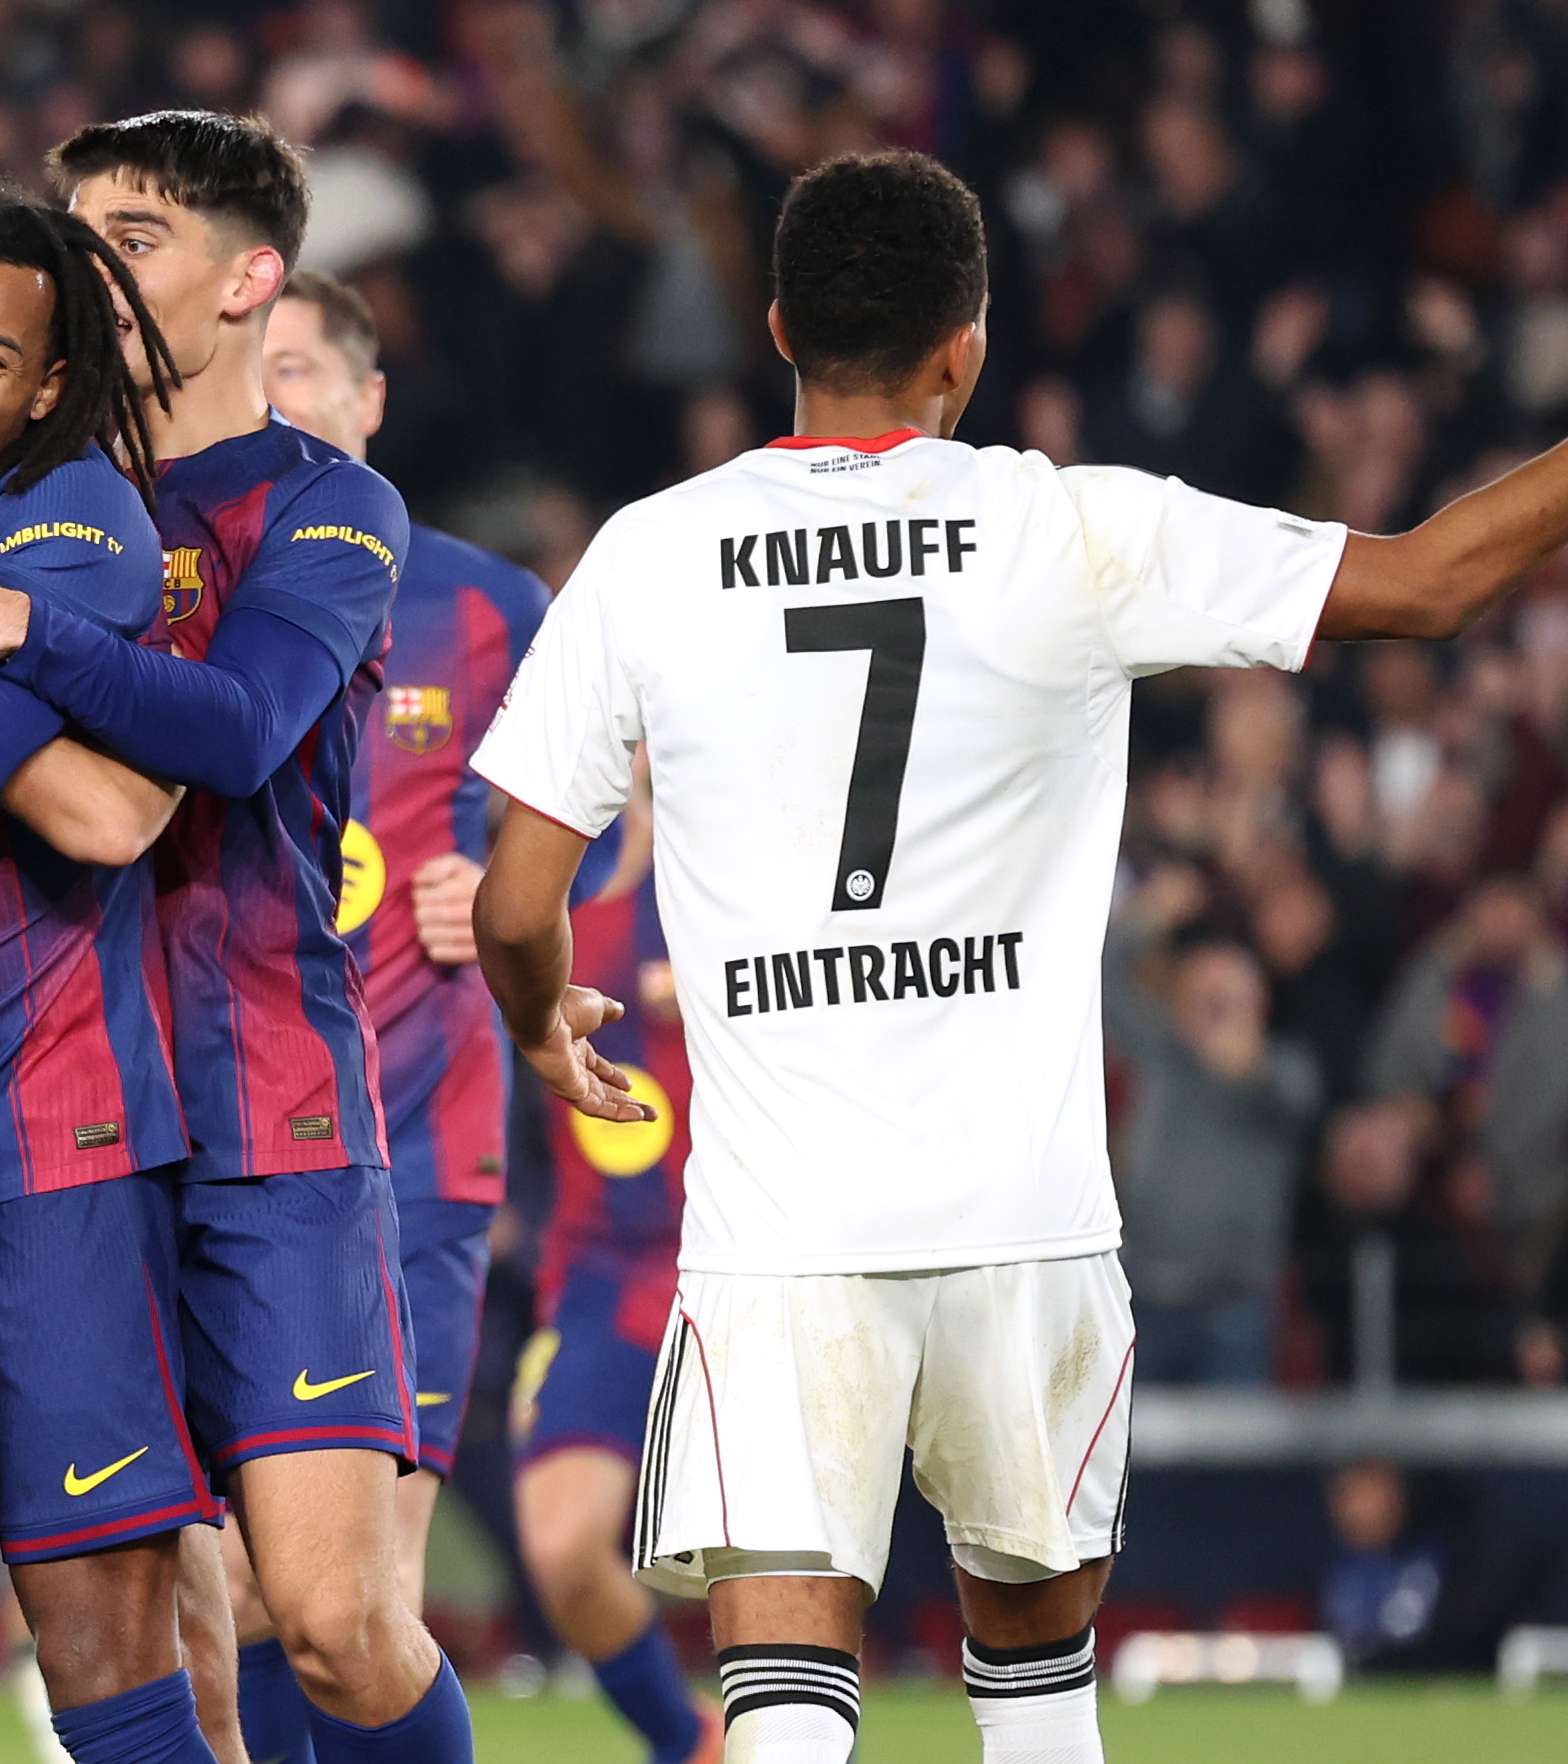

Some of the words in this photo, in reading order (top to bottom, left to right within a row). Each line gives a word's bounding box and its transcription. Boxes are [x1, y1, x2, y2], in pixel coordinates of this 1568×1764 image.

[290, 525, 395, 567] AMBILIGHT
[720, 519, 976, 590] KNAUFF
[784, 596, 926, 912] 7
[724, 931, 1024, 1018] EINTRACHT
